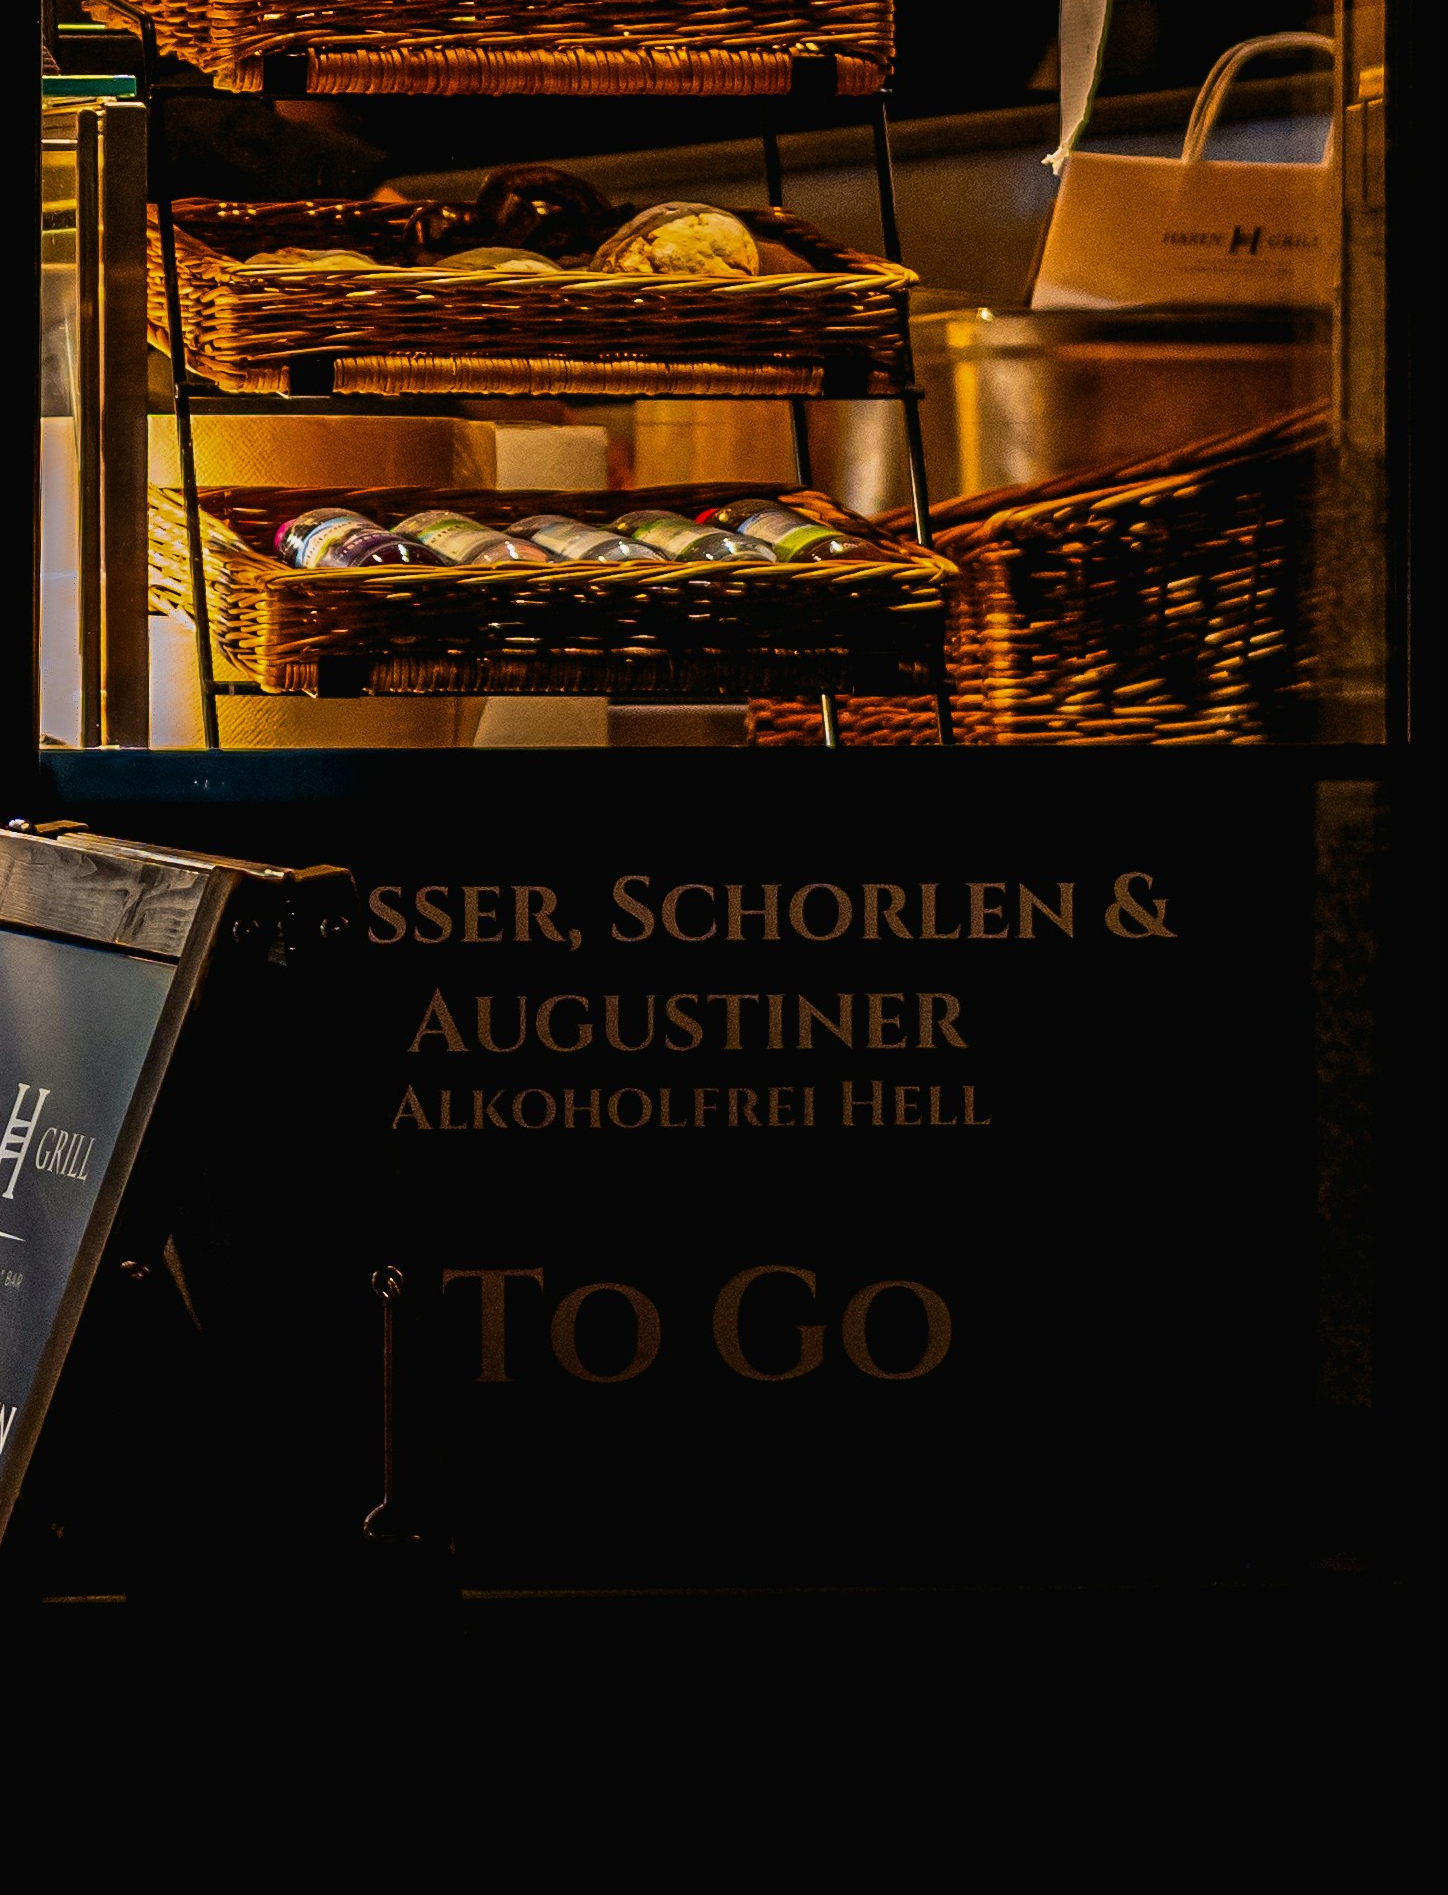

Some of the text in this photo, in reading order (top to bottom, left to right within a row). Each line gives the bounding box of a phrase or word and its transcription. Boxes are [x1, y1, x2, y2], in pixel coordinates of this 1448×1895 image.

[367, 870, 1178, 952] SSER, SCHORLEN &
[407, 987, 969, 1054] AUGUSTINER
[390, 1079, 993, 1131] ALKOHOLFREI HELL
[35, 1126, 96, 1182] GRILL
[4, 1269, 25, 1289] BAR
[441, 1264, 953, 1383] TO GO
